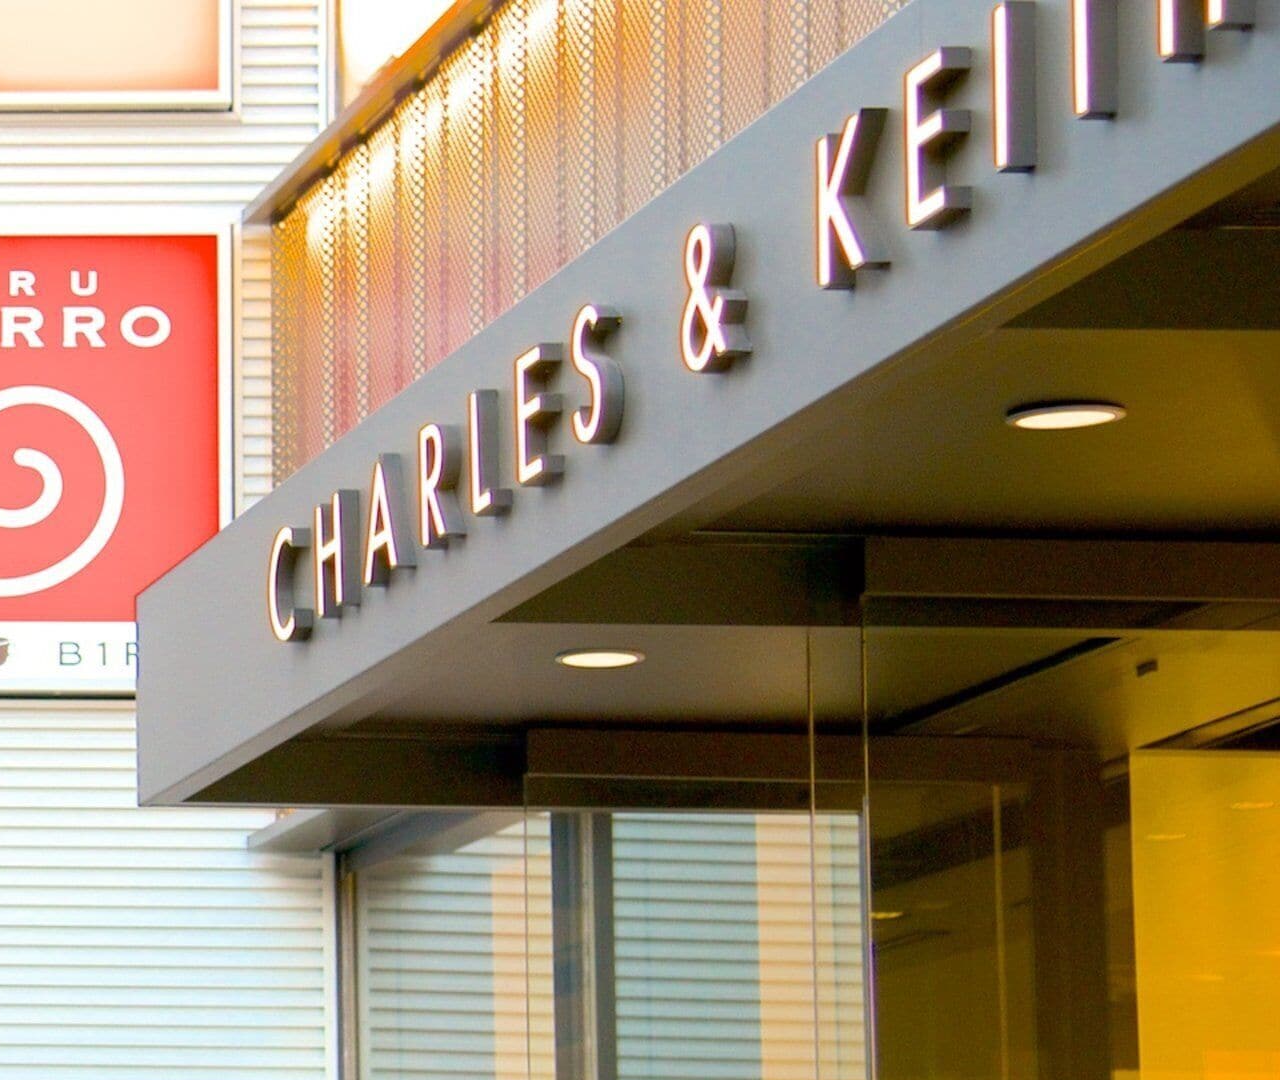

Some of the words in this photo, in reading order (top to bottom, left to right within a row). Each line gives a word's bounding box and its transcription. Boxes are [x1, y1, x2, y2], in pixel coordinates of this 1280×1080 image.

[268, 304, 622, 642] CHARLES
[681, 222, 751, 373] &
[816, 0, 1256, 290] KEI
